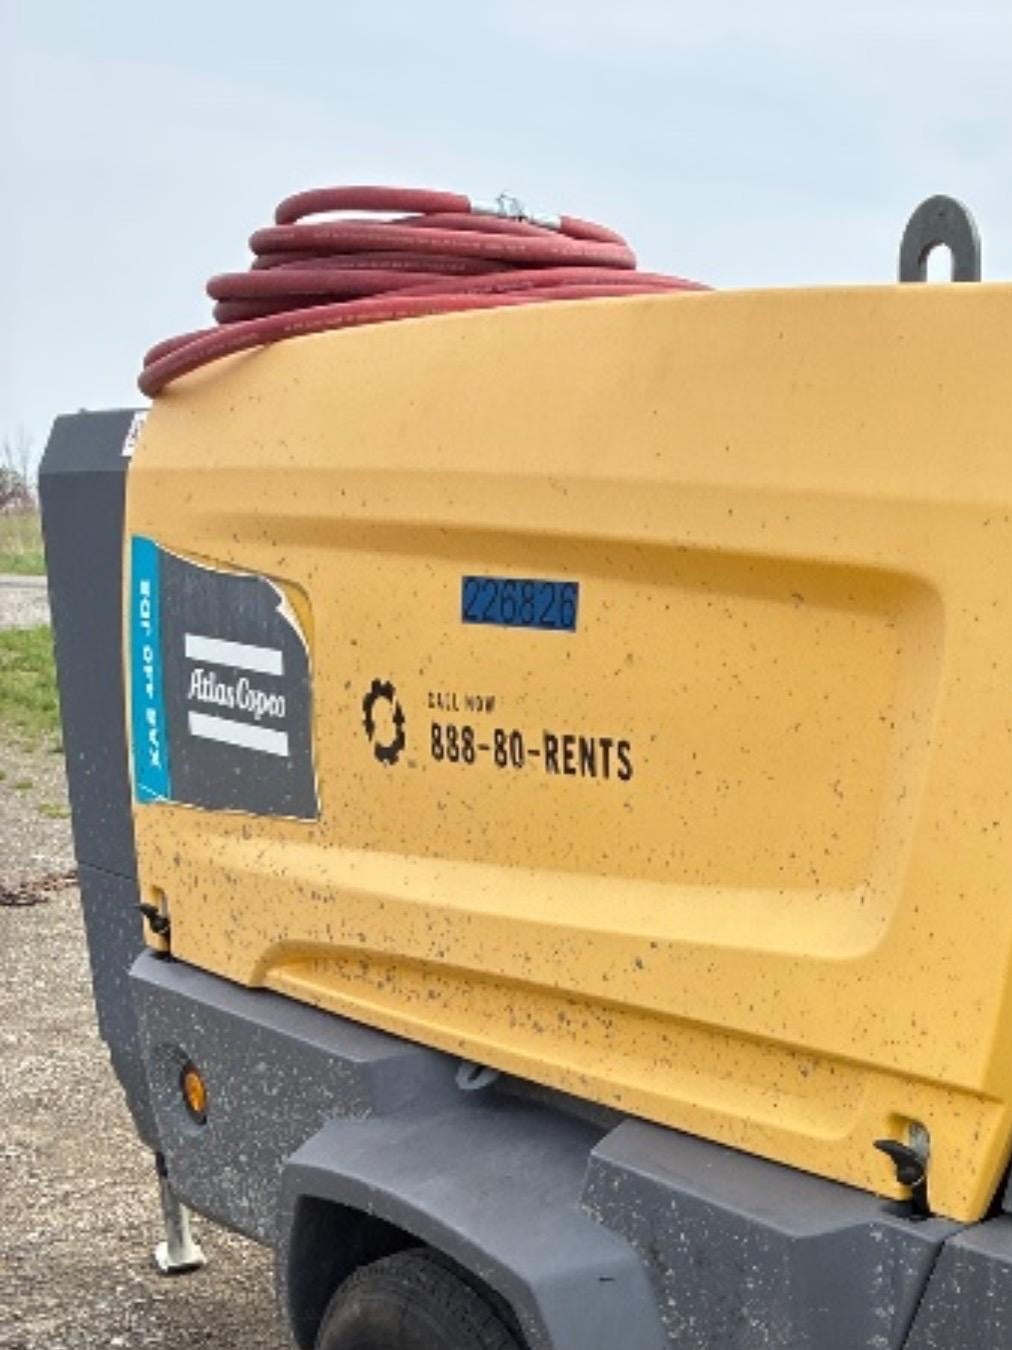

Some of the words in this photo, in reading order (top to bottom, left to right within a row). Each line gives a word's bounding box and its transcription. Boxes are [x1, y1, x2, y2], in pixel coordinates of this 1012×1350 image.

[463, 577, 577, 630] 226826
[188, 668, 234, 709] Atlas
[236, 677, 285, 720] Copco
[428, 691, 460, 712] CALL
[465, 695, 496, 713] NOW
[431, 721, 634, 782] 888-80-RENTS
